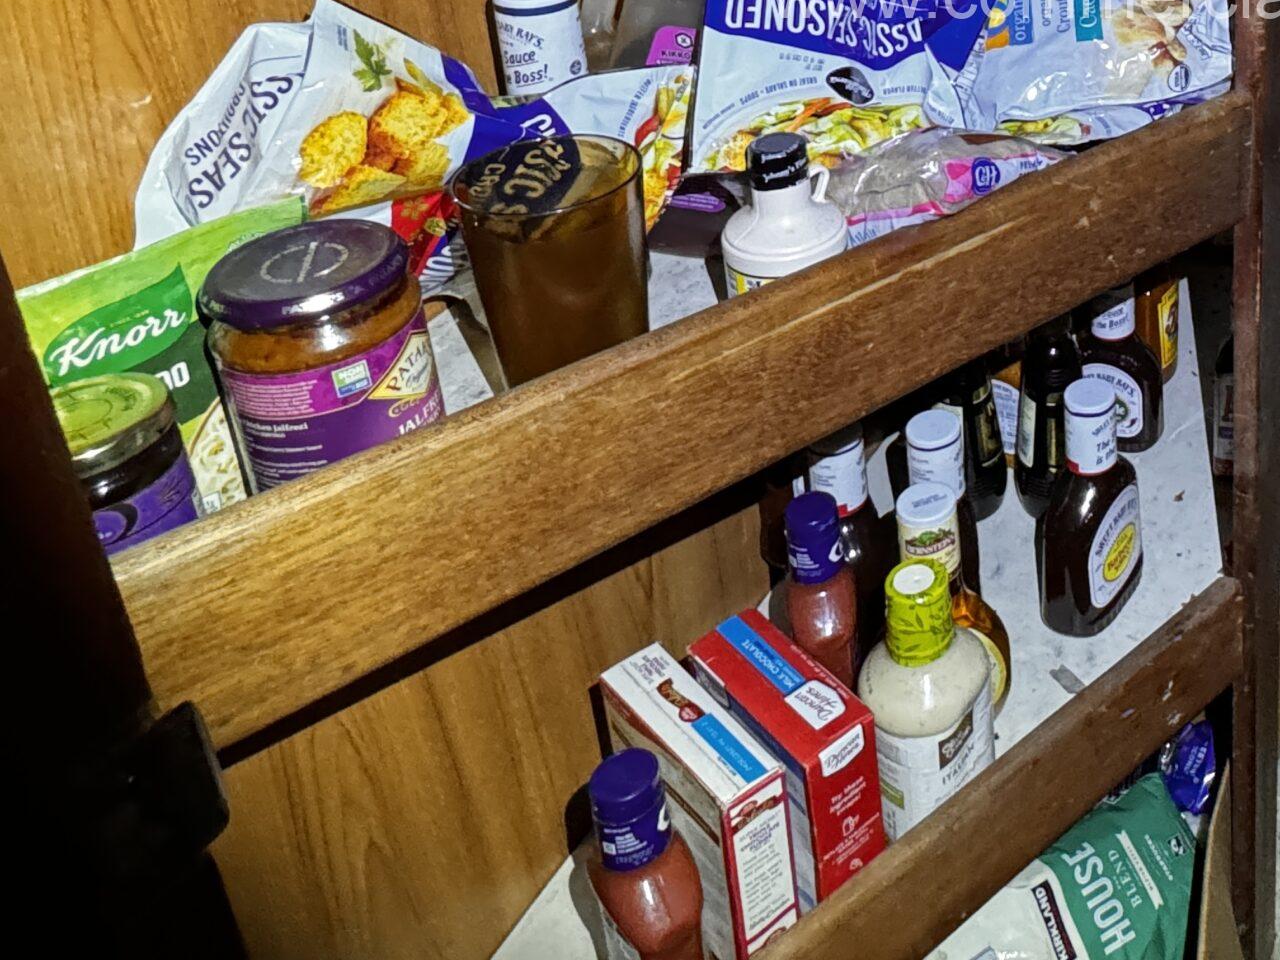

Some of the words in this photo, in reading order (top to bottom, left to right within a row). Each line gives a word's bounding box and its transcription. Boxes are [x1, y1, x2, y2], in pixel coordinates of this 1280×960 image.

[514, 63, 548, 85] Boss!
[49, 308, 187, 377] Knorr
[741, 638, 780, 677] CHOCOLATE
[778, 674, 796, 691] MILK
[805, 685, 838, 709] Hines
[793, 691, 834, 721] Duncan
[942, 742, 975, 786] ITALIAN
[1061, 840, 1137, 957] HOUSE
[1108, 849, 1144, 909] BLEND
